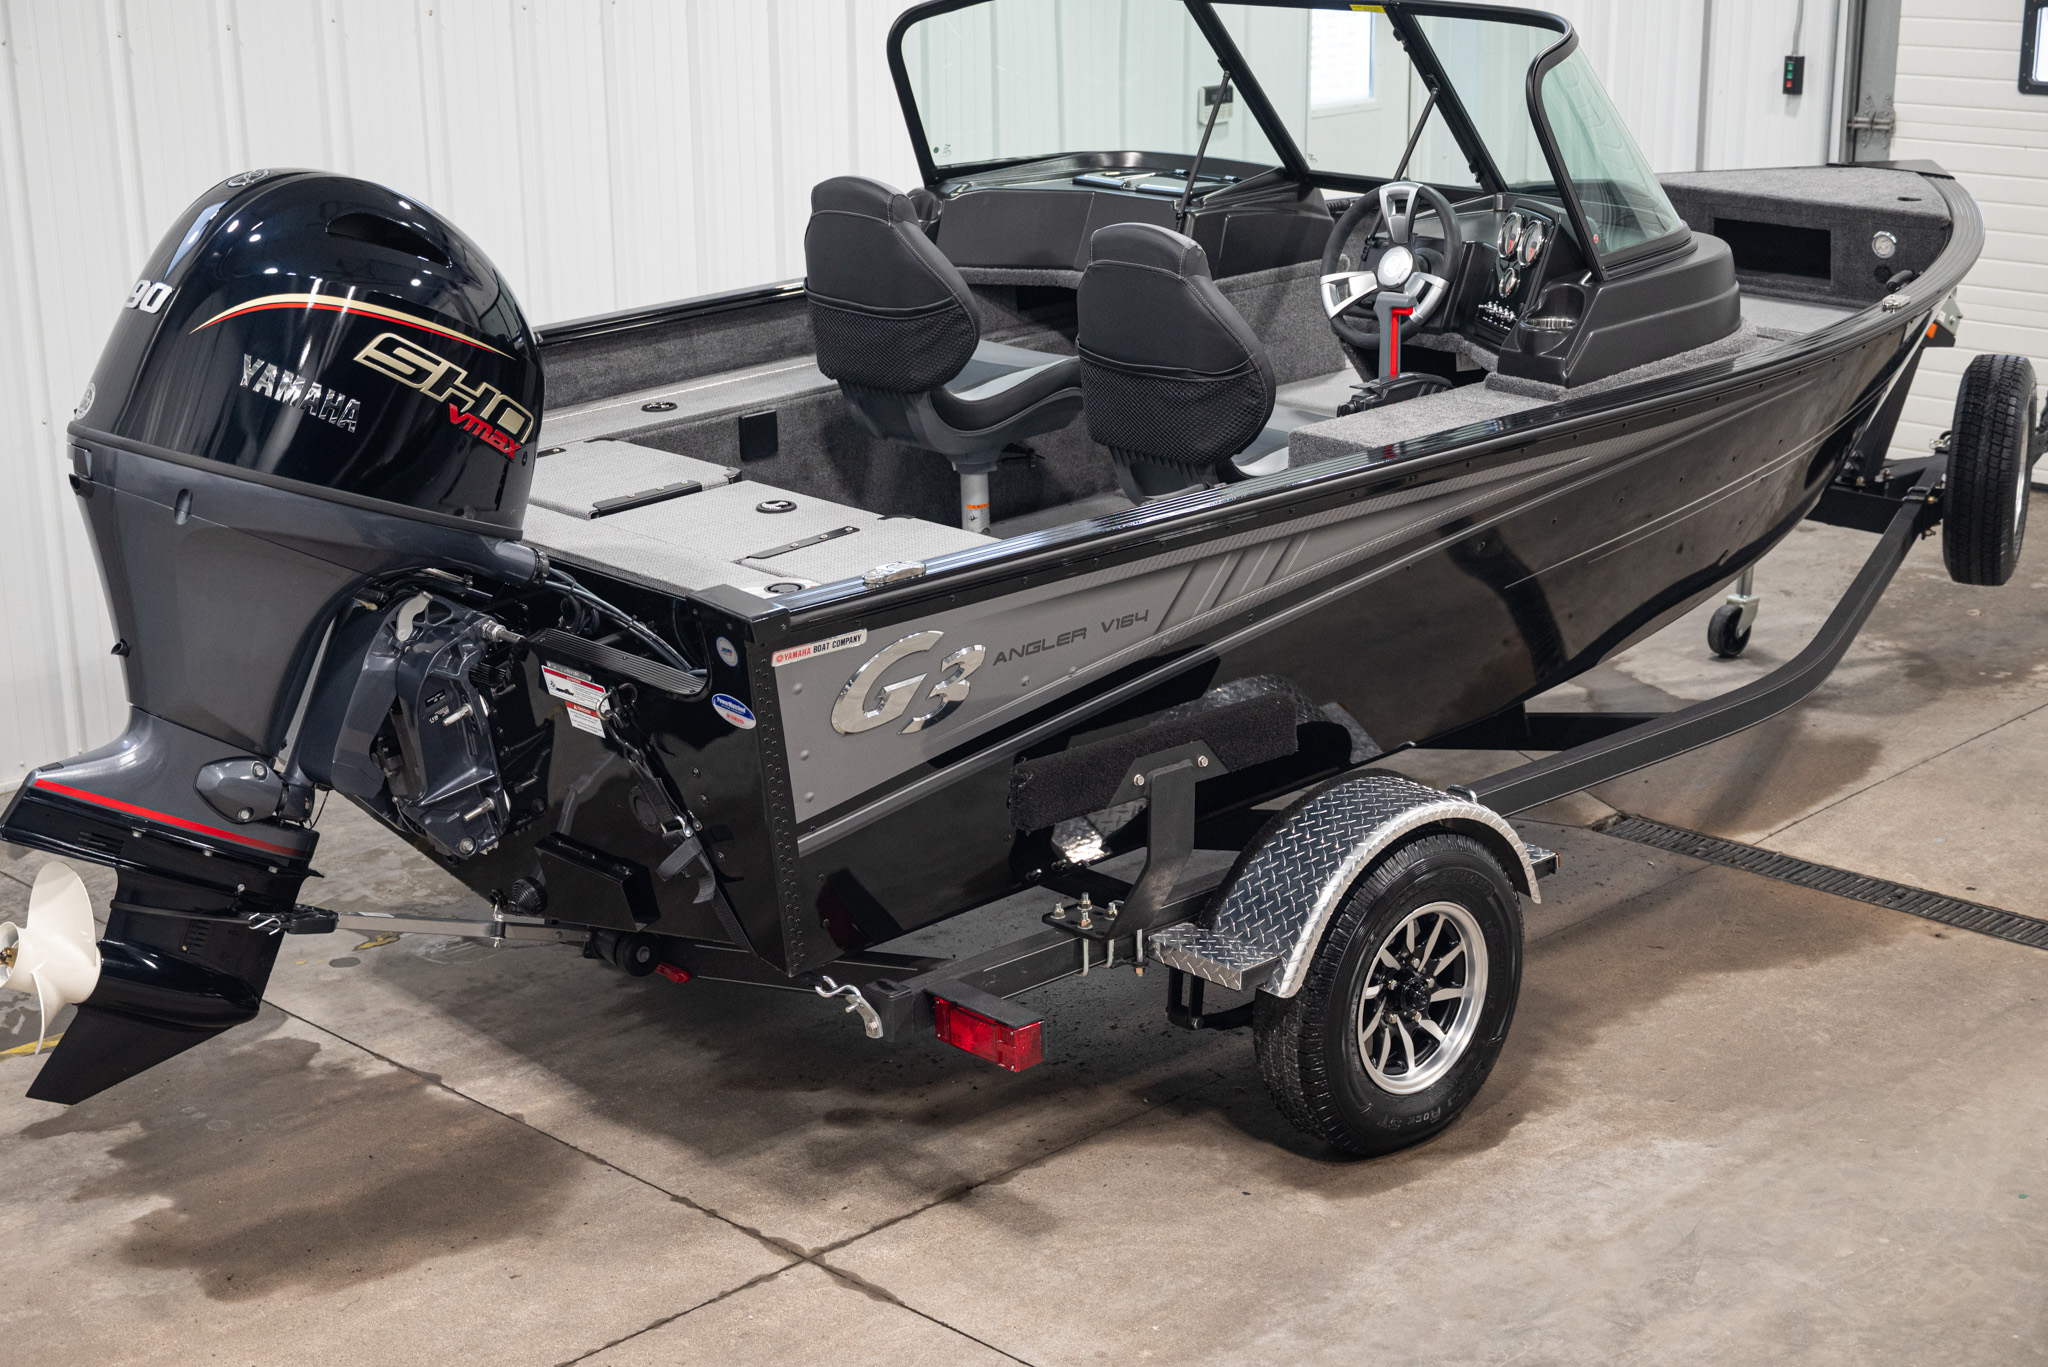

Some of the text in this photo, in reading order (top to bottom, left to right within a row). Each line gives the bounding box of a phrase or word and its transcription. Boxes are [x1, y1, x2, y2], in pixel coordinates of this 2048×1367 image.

[124, 280, 173, 314] 90
[240, 353, 361, 433] YAMAHA
[353, 332, 535, 444] SHO
[784, 634, 862, 661] YAMAHA BOAT COMPANY
[992, 609, 1149, 666] ANGLER V164
[831, 630, 986, 736] G3
